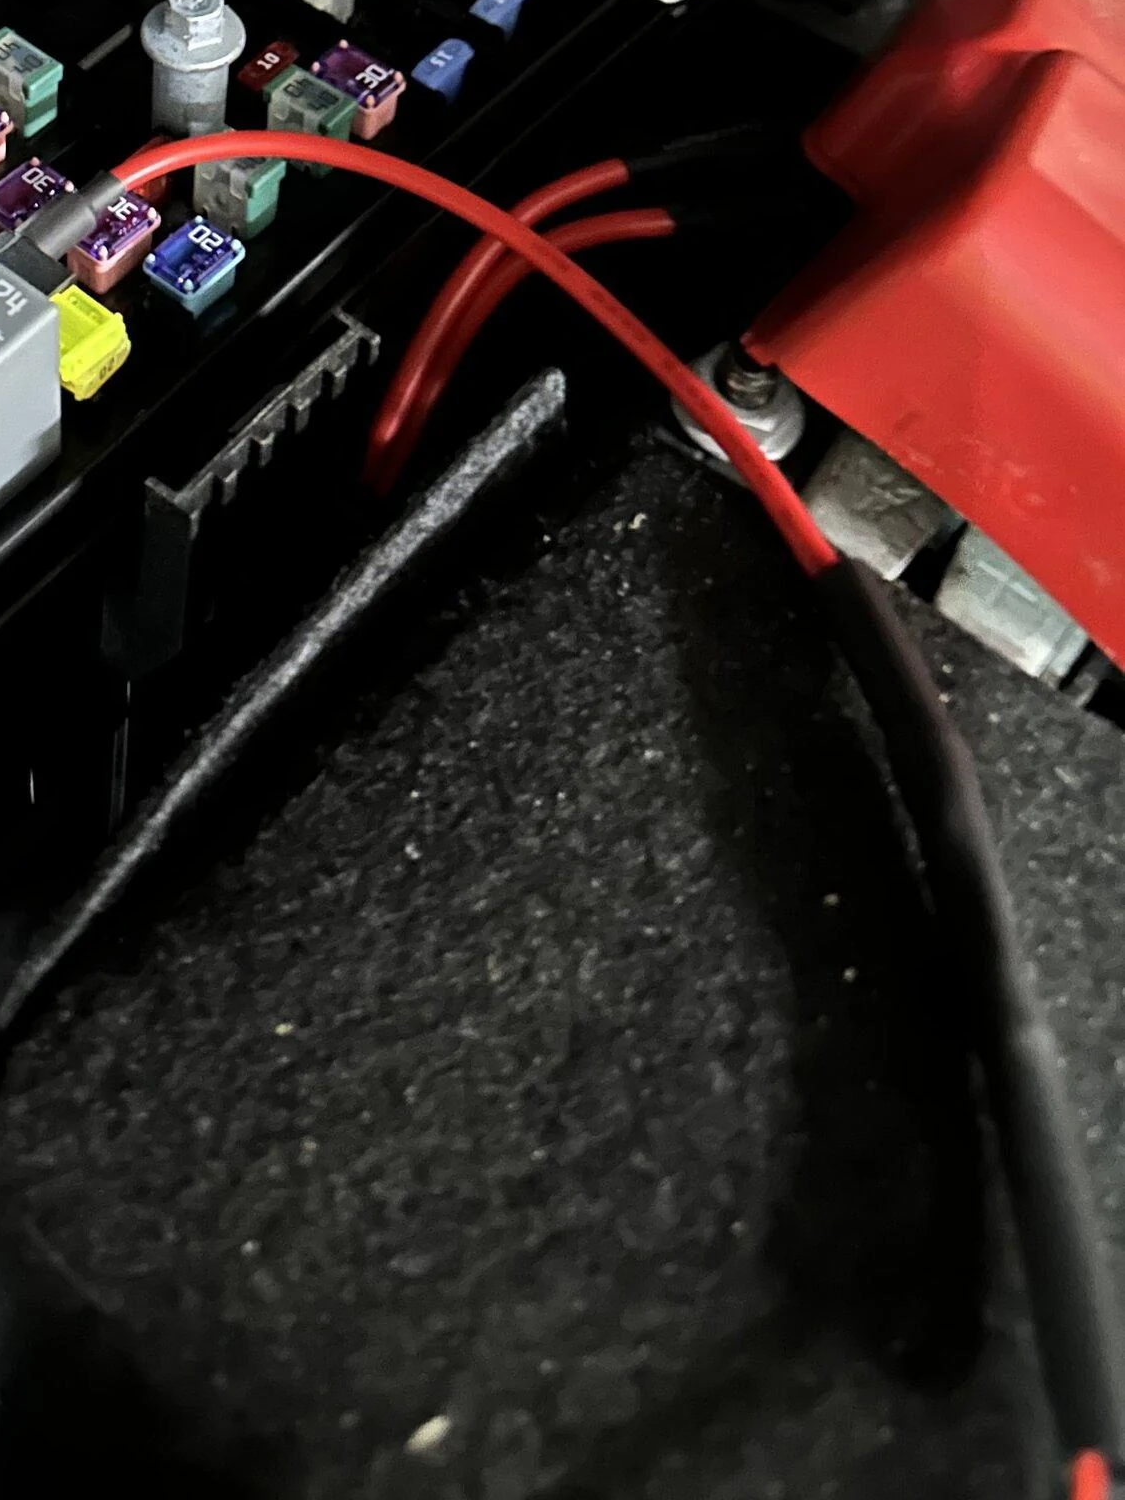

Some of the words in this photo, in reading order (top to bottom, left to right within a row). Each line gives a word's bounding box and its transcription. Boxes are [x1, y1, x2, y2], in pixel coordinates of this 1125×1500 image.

[257, 52, 281, 70] 10
[355, 64, 387, 90] 30
[22, 168, 54, 192] 30
[188, 225, 224, 252] 20
